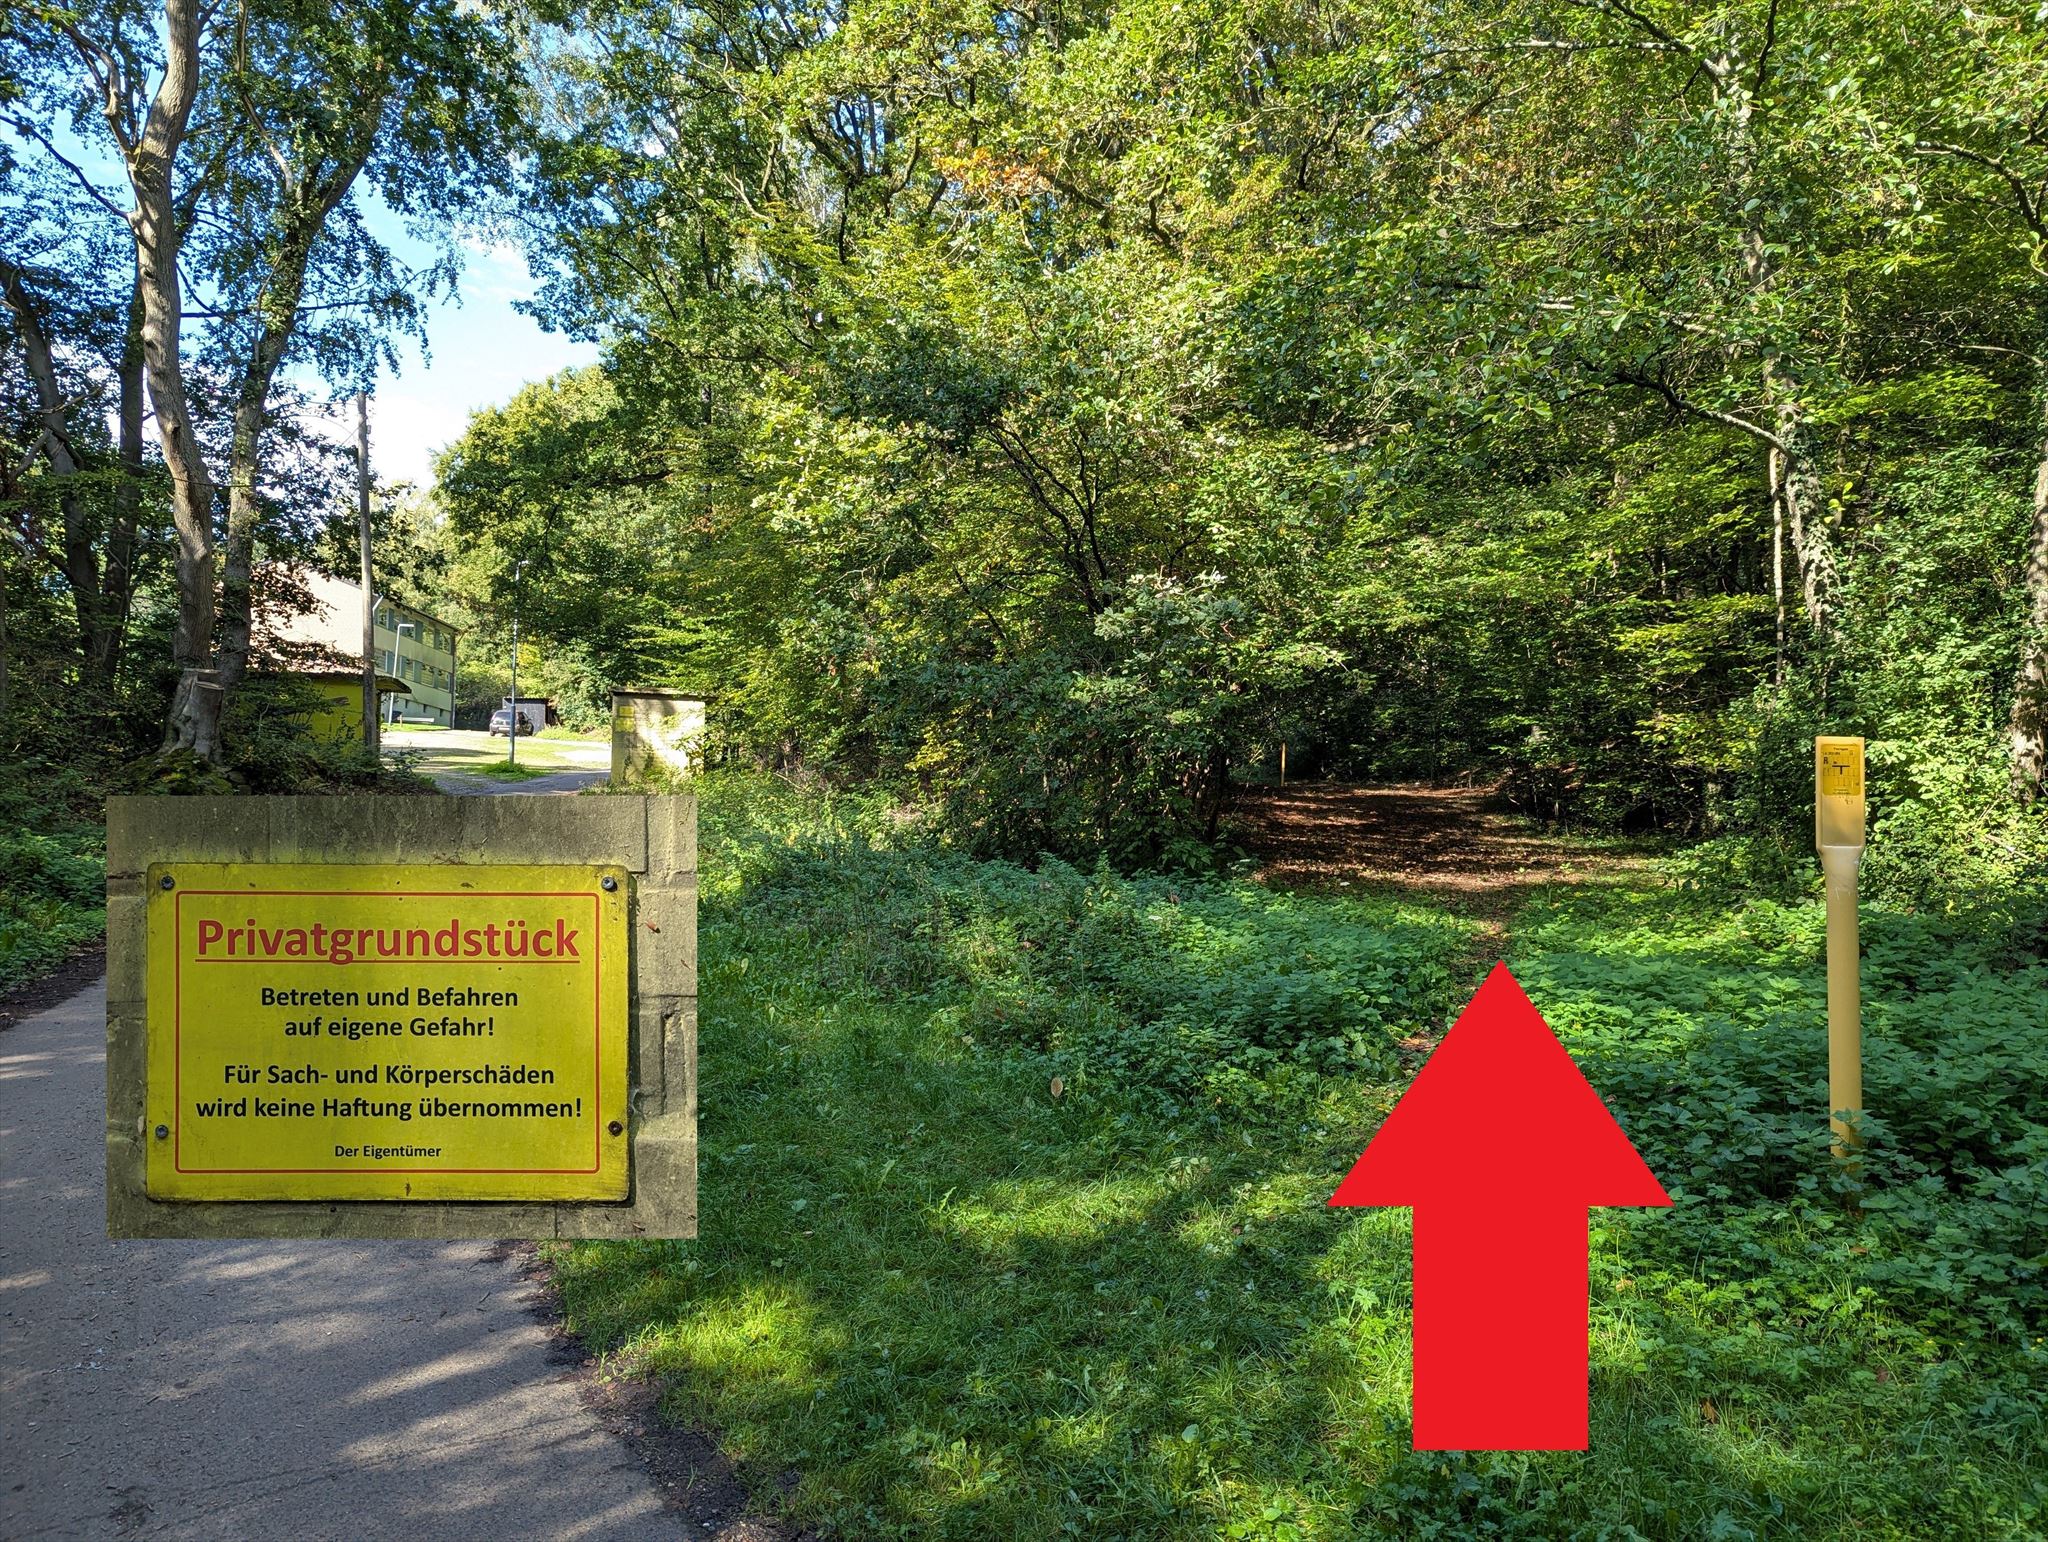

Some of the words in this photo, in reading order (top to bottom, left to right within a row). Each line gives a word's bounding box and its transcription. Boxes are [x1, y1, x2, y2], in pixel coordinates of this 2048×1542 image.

[198, 918, 579, 965] Privatgrundstück
[261, 987, 359, 1007] Betreten
[366, 986, 409, 1007] und
[417, 986, 518, 1007] Befahren
[284, 1016, 323, 1037] auf
[327, 1016, 403, 1041] eigene
[409, 1016, 494, 1037] Gefahr!
[224, 1065, 262, 1084] Für
[267, 1064, 328, 1084] Sach-
[335, 1064, 378, 1084] und
[385, 1064, 554, 1089] Körperschäden
[195, 1097, 247, 1118] wird
[254, 1096, 316, 1118] keine
[322, 1097, 413, 1122] Haftung
[419, 1097, 581, 1118] übernommen!
[334, 1145, 360, 1158] Der
[363, 1144, 442, 1160] Eigentümer
